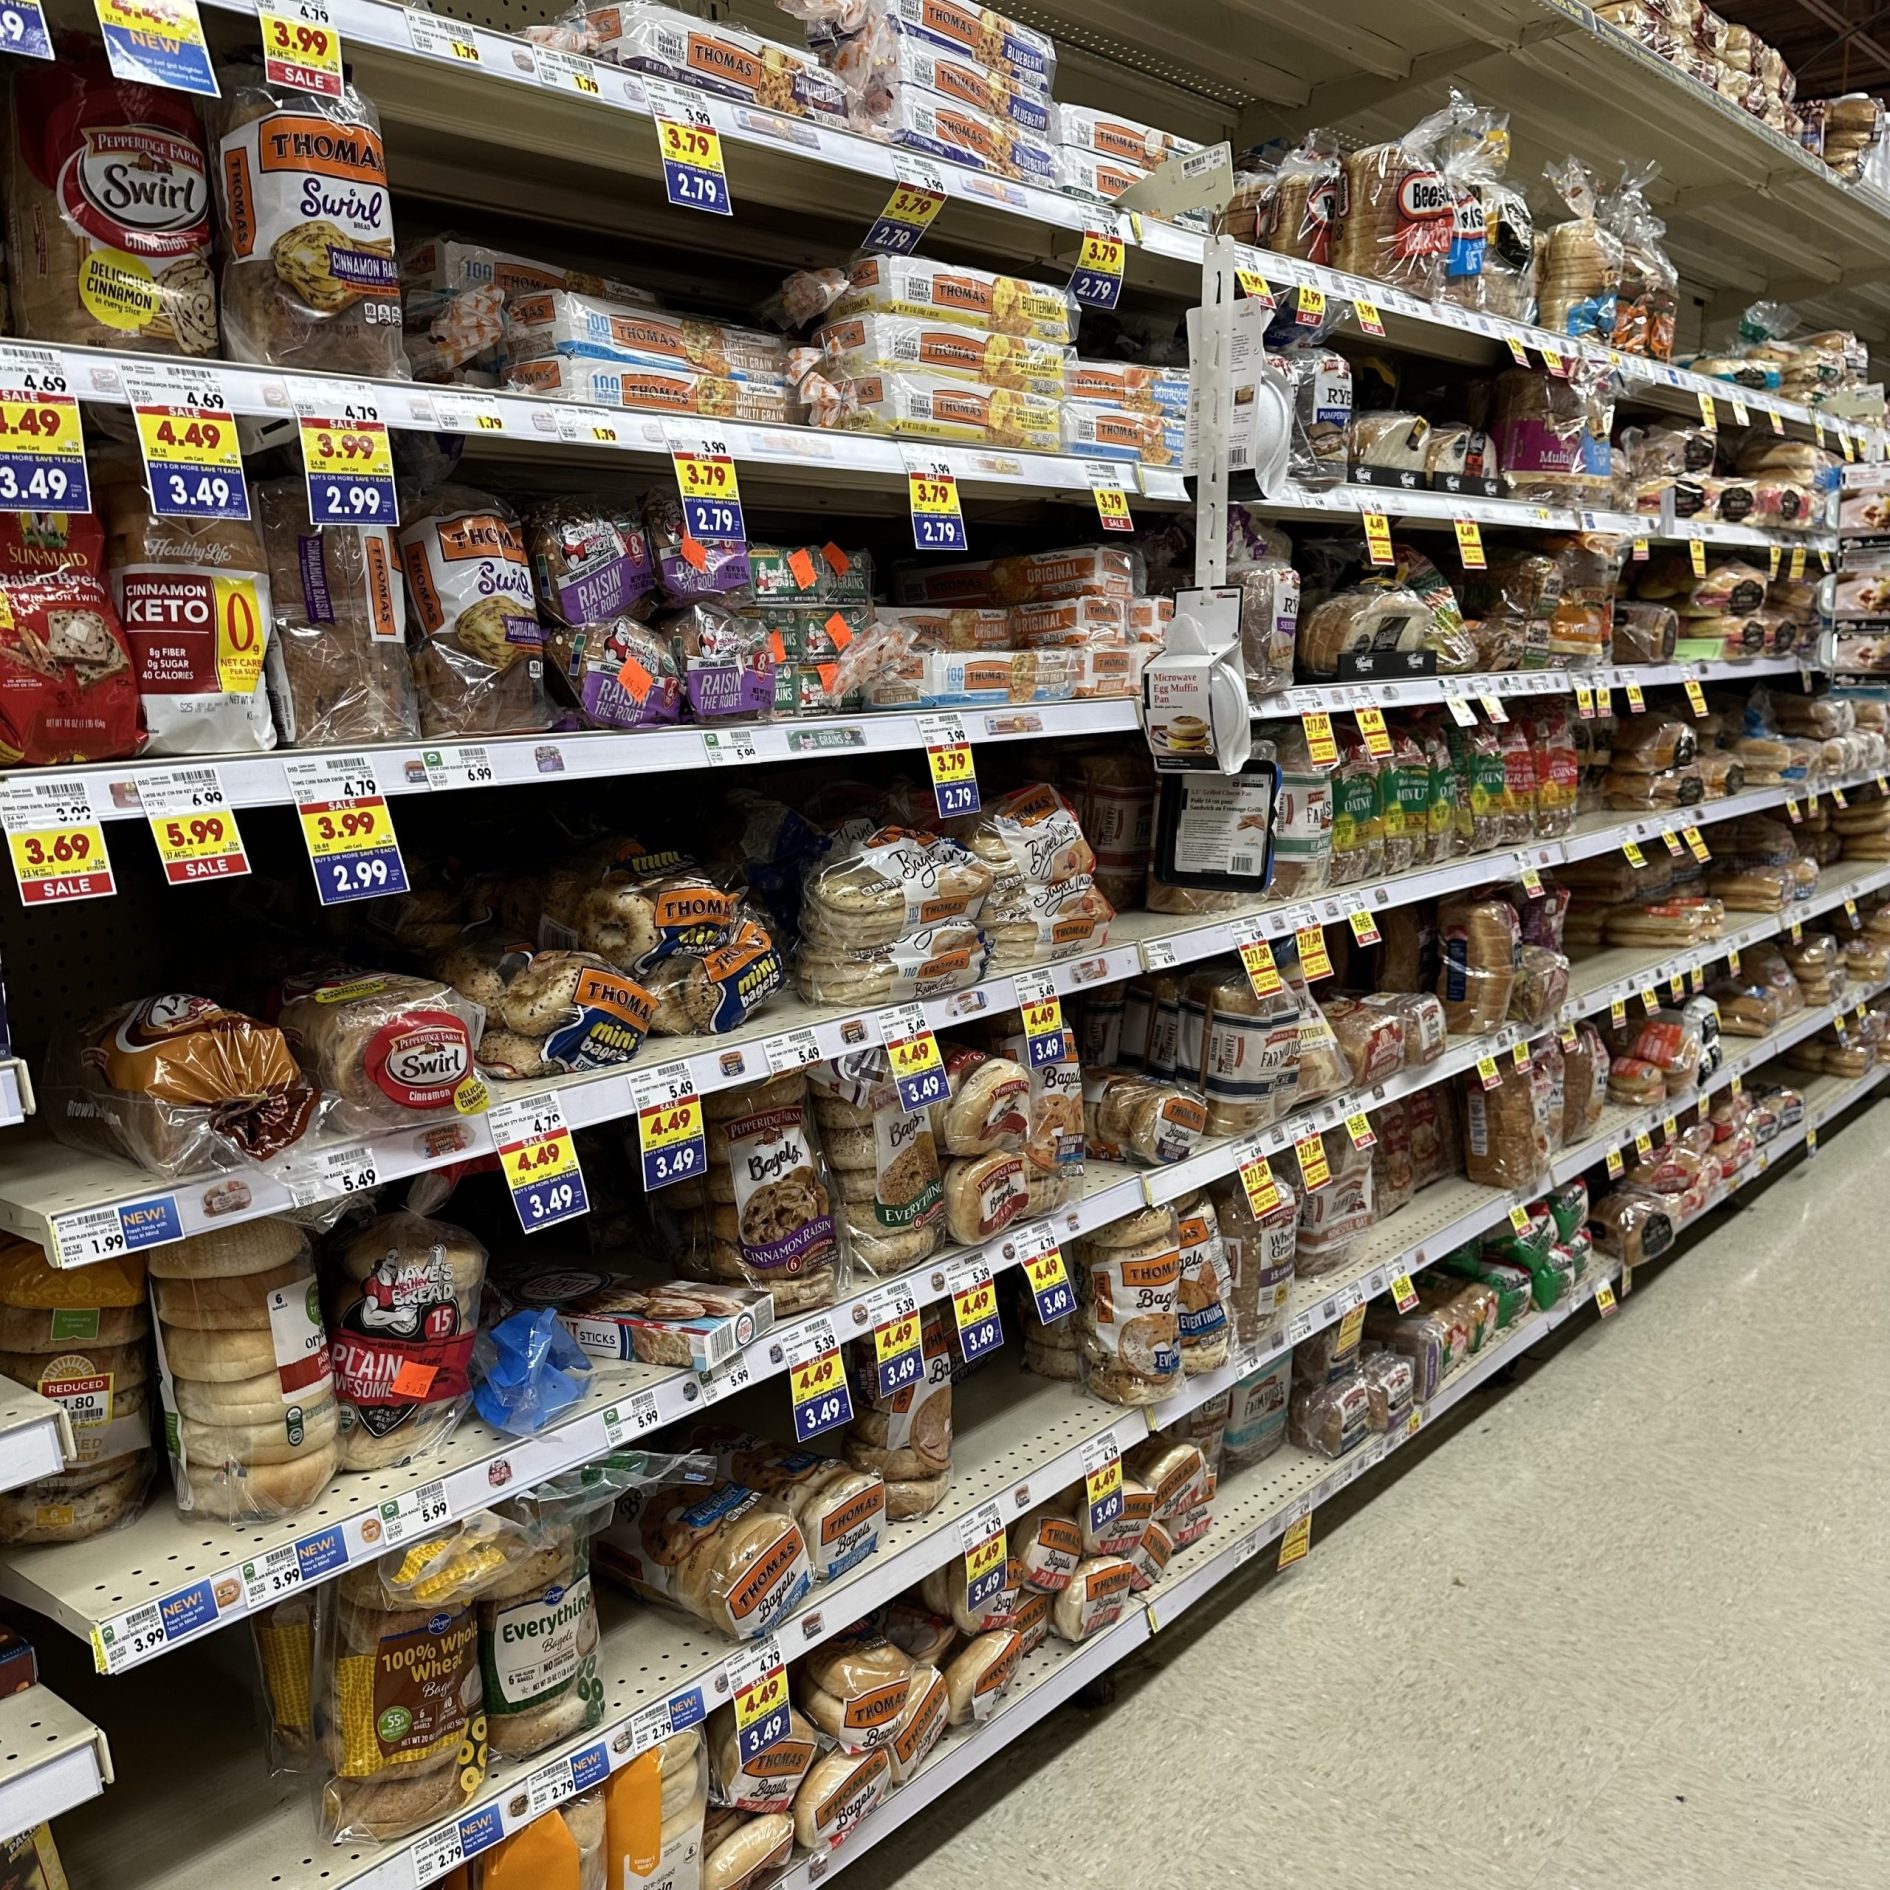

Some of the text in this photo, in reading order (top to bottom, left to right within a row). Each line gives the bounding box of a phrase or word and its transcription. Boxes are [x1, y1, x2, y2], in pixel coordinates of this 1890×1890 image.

[130, 30, 180, 55] NEW
[273, 21, 328, 56] 3.99
[452, 44, 479, 60] 1.79
[694, 46, 753, 76] THOMAS
[1006, 44, 1043, 72] BLUEBERRY
[284, 68, 324, 89] SALE
[575, 75, 599, 94] 1.79
[1013, 104, 1046, 130] BLUEBERRY
[98, 134, 200, 166] PEPPERIDGE FARM
[667, 128, 709, 156] 3.79
[1014, 152, 1049, 174] BLUEBERRY
[103, 163, 196, 214] Swirl
[677, 173, 716, 202] 2.79
[300, 178, 383, 228] Swirl
[353, 222, 371, 231] BREAD
[332, 251, 381, 276] CINNAMON
[1089, 245, 1117, 263] 3.79
[466, 259, 491, 281] 100
[1241, 273, 1263, 289] 3.99
[87, 278, 153, 309] CINNAMON
[1077, 277, 1111, 299] 2.79
[1302, 289, 1322, 306] 3.99
[585, 313, 676, 348] 100 THOMAS
[24, 375, 66, 392] 4.69
[187, 392, 224, 408] 4.69
[1327, 388, 1352, 405] RYE
[345, 405, 377, 420] 4.79
[157, 421, 221, 449] 4.49
[593, 427, 616, 441] 1.79
[317, 434, 374, 459] 3.99
[223, 467, 240, 475] EACH
[686, 464, 726, 486] 3.79
[169, 475, 229, 507] 3.49
[326, 486, 380, 514] 2.99
[918, 483, 948, 503] 3.79
[1101, 493, 1122, 509] 3.79
[696, 509, 733, 531] 2.79
[923, 522, 954, 541] 2.79
[144, 539, 231, 563] Healthy Life
[306, 539, 331, 619] CINNAMON RAISIN
[1027, 566, 1079, 584] ORIGINAL
[126, 584, 207, 597] CINNAMON
[127, 600, 209, 624] KETO
[581, 589, 624, 622] THE ROOF!
[149, 648, 186, 658] 8g FIBER
[143, 671, 194, 680] 40 CALORIES
[147, 659, 189, 670] 0g SUGAR
[1153, 672, 1197, 683] Microwave
[1153, 683, 1198, 694] Egg Muffin
[1153, 694, 1170, 704] Pan
[1306, 718, 1328, 732] 2/7.00
[819, 733, 844, 746] GRAINS
[937, 753, 966, 772] 3.79
[468, 768, 492, 782] 6.99
[344, 780, 376, 797] 4.79
[945, 789, 972, 809] 2.79
[167, 818, 224, 847] 5.99
[317, 811, 375, 840] 3.99
[25, 833, 90, 864] 3.69
[186, 859, 229, 876] SALE
[332, 859, 388, 892] 2.99
[43, 879, 91, 897] SALE
[1299, 933, 1322, 950] 2/7.00
[1244, 947, 1269, 967] 2/7.00
[738, 954, 776, 994] mini
[1030, 1010, 1054, 1026] 4.49
[400, 1032, 460, 1048] PEPPERIDGE FARM
[590, 1021, 637, 1050] mini
[798, 1049, 819, 1063] 5.49
[1035, 1040, 1058, 1058] 3.49
[401, 1053, 461, 1078] Swirl
[409, 1088, 451, 1102] Cinnamon
[669, 1081, 693, 1098] 5.49
[908, 1078, 939, 1103] 3.49
[650, 1108, 691, 1136] 4.49
[730, 1111, 801, 1139] PEPPERIDGE FARM
[517, 1143, 560, 1171] 4.49
[656, 1148, 694, 1178] 3.49
[747, 1141, 803, 1181] Bagels
[343, 1169, 376, 1191] 5.49
[1243, 1164, 1268, 1185] 2/7.00
[529, 1184, 573, 1218] 3.49
[884, 1181, 943, 1222] EVERYTHING
[123, 1206, 166, 1226] NEW!
[91, 1235, 124, 1254] 1.99
[744, 1219, 832, 1263] CINNAMON RAISIN
[1043, 1292, 1068, 1314] 3.49
[431, 1309, 450, 1332] 15
[1180, 1304, 1223, 1330] EVERYTHING
[580, 1329, 616, 1345] STICKS
[814, 1334, 835, 1352] 5.39
[883, 1322, 912, 1349] 4.49
[968, 1328, 994, 1352] 3.49
[332, 1342, 403, 1381] PLAIN
[887, 1357, 915, 1385] 3.49
[730, 1369, 748, 1387] 5.99
[800, 1361, 833, 1390] 4.49
[48, 1380, 104, 1394] REDUCED
[638, 1410, 658, 1428] 5.99
[805, 1397, 840, 1429] 3.49
[422, 1502, 447, 1522] 5.99
[299, 1535, 336, 1560] NEW!
[836, 1522, 872, 1556] Bagels
[272, 1568, 300, 1590] 3.99
[974, 1572, 1000, 1601] 3.49
[163, 1591, 203, 1619] NEW!
[760, 1570, 796, 1624] Bagels
[428, 1616, 451, 1633] Kroger
[134, 1628, 164, 1653] 3.99
[381, 1622, 478, 1673] 100% Whole
[411, 1651, 464, 1683] Wheat
[744, 1681, 779, 1713] 4.49
[749, 1716, 781, 1750] 3.49
[573, 1752, 600, 1773] NEW!
[750, 1778, 788, 1800] Bagels
[836, 1784, 876, 1830] Bagels
[461, 1813, 493, 1838] NEW!
